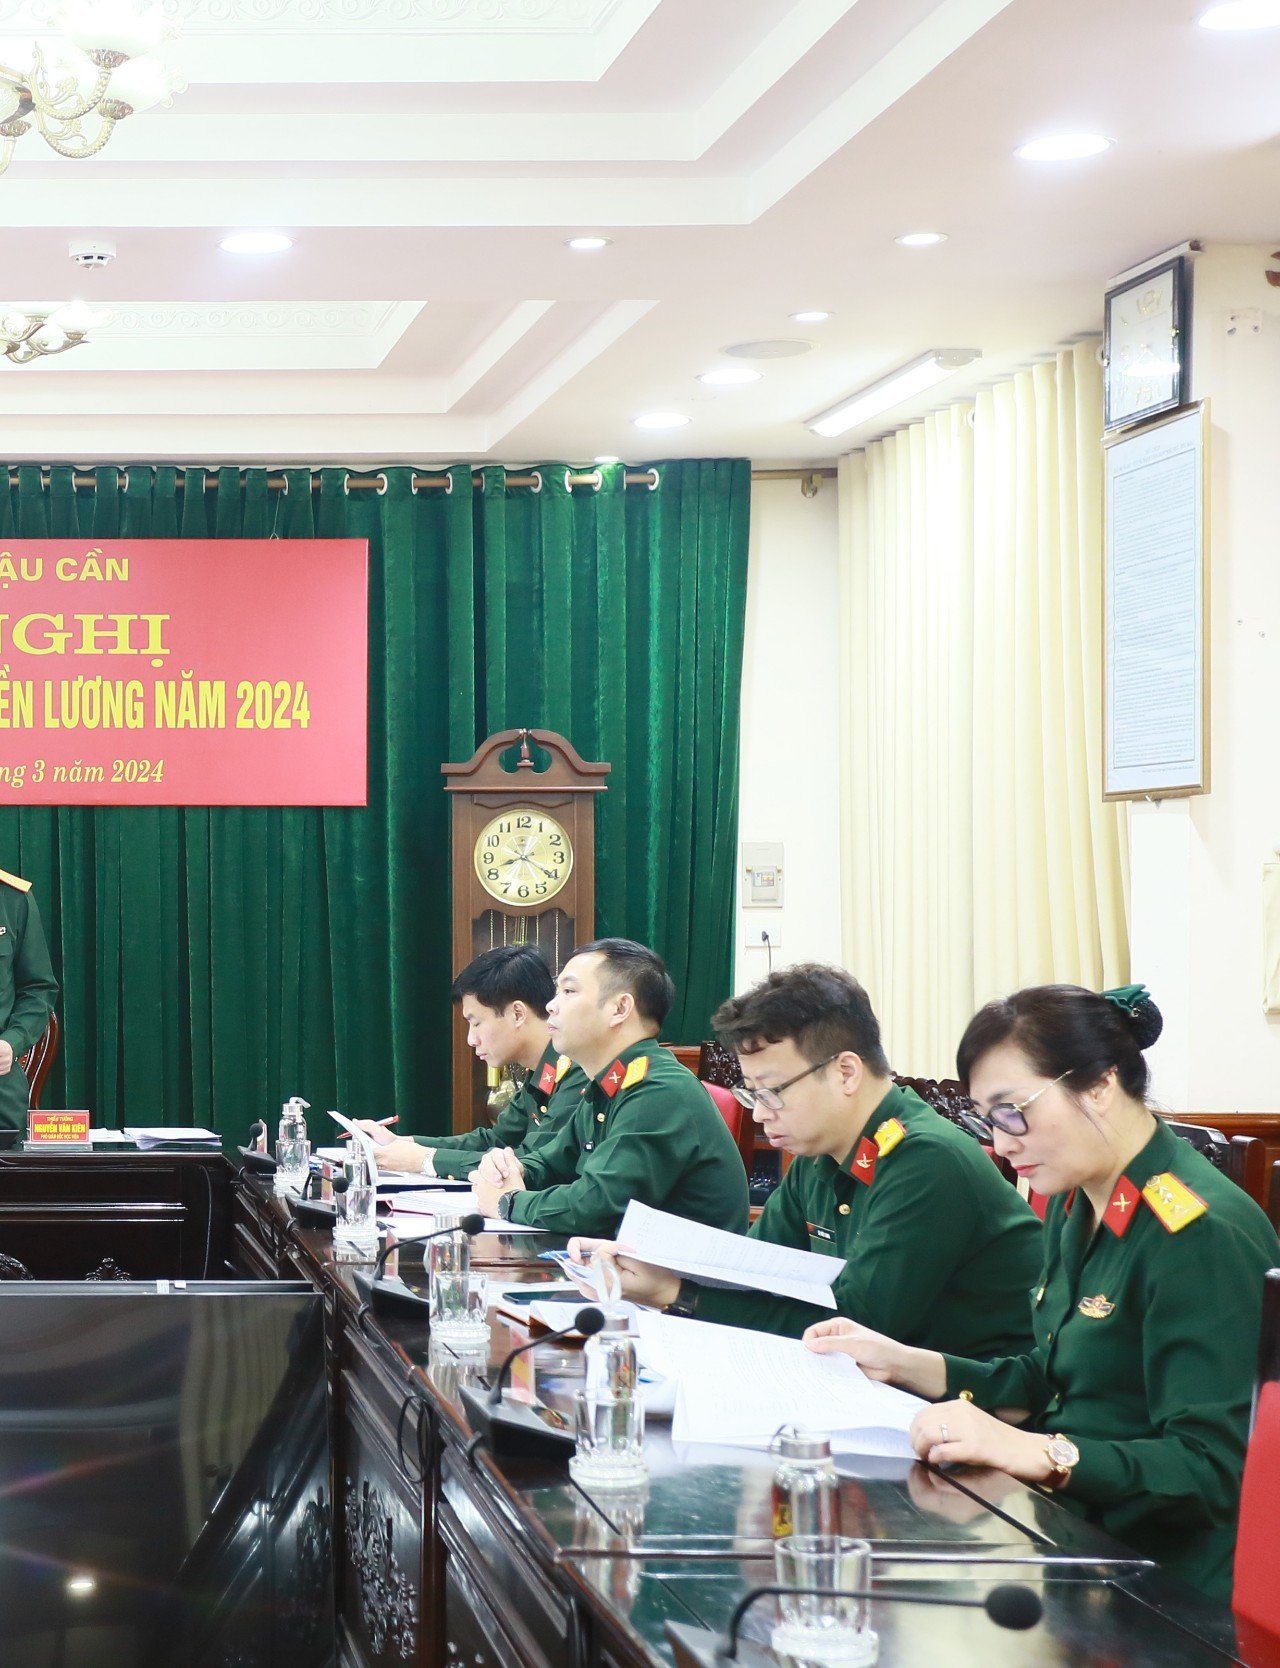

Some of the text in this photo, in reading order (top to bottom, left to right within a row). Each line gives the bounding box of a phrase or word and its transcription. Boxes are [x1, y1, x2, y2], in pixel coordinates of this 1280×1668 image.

[55, 548, 129, 582] CẦN
[44, 675, 145, 730] LƯƠNG
[154, 668, 226, 730] NĂM
[235, 680, 311, 730] 2024
[32, 759, 46, 783] 3
[54, 761, 106, 783] năm
[111, 759, 164, 783] 2024
[499, 822, 511, 833] 11
[516, 815, 532, 829] 12
[538, 822, 543, 833] 1
[487, 835, 500, 848] 10
[549, 834, 562, 846] 2
[483, 852, 495, 864] 9
[553, 851, 565, 864] 3
[487, 868, 499, 881] 8
[500, 882, 512, 894] 7
[517, 885, 530, 898] 6
[535, 881, 547, 895] 5
[59, 1122, 71, 1133] VĂN
